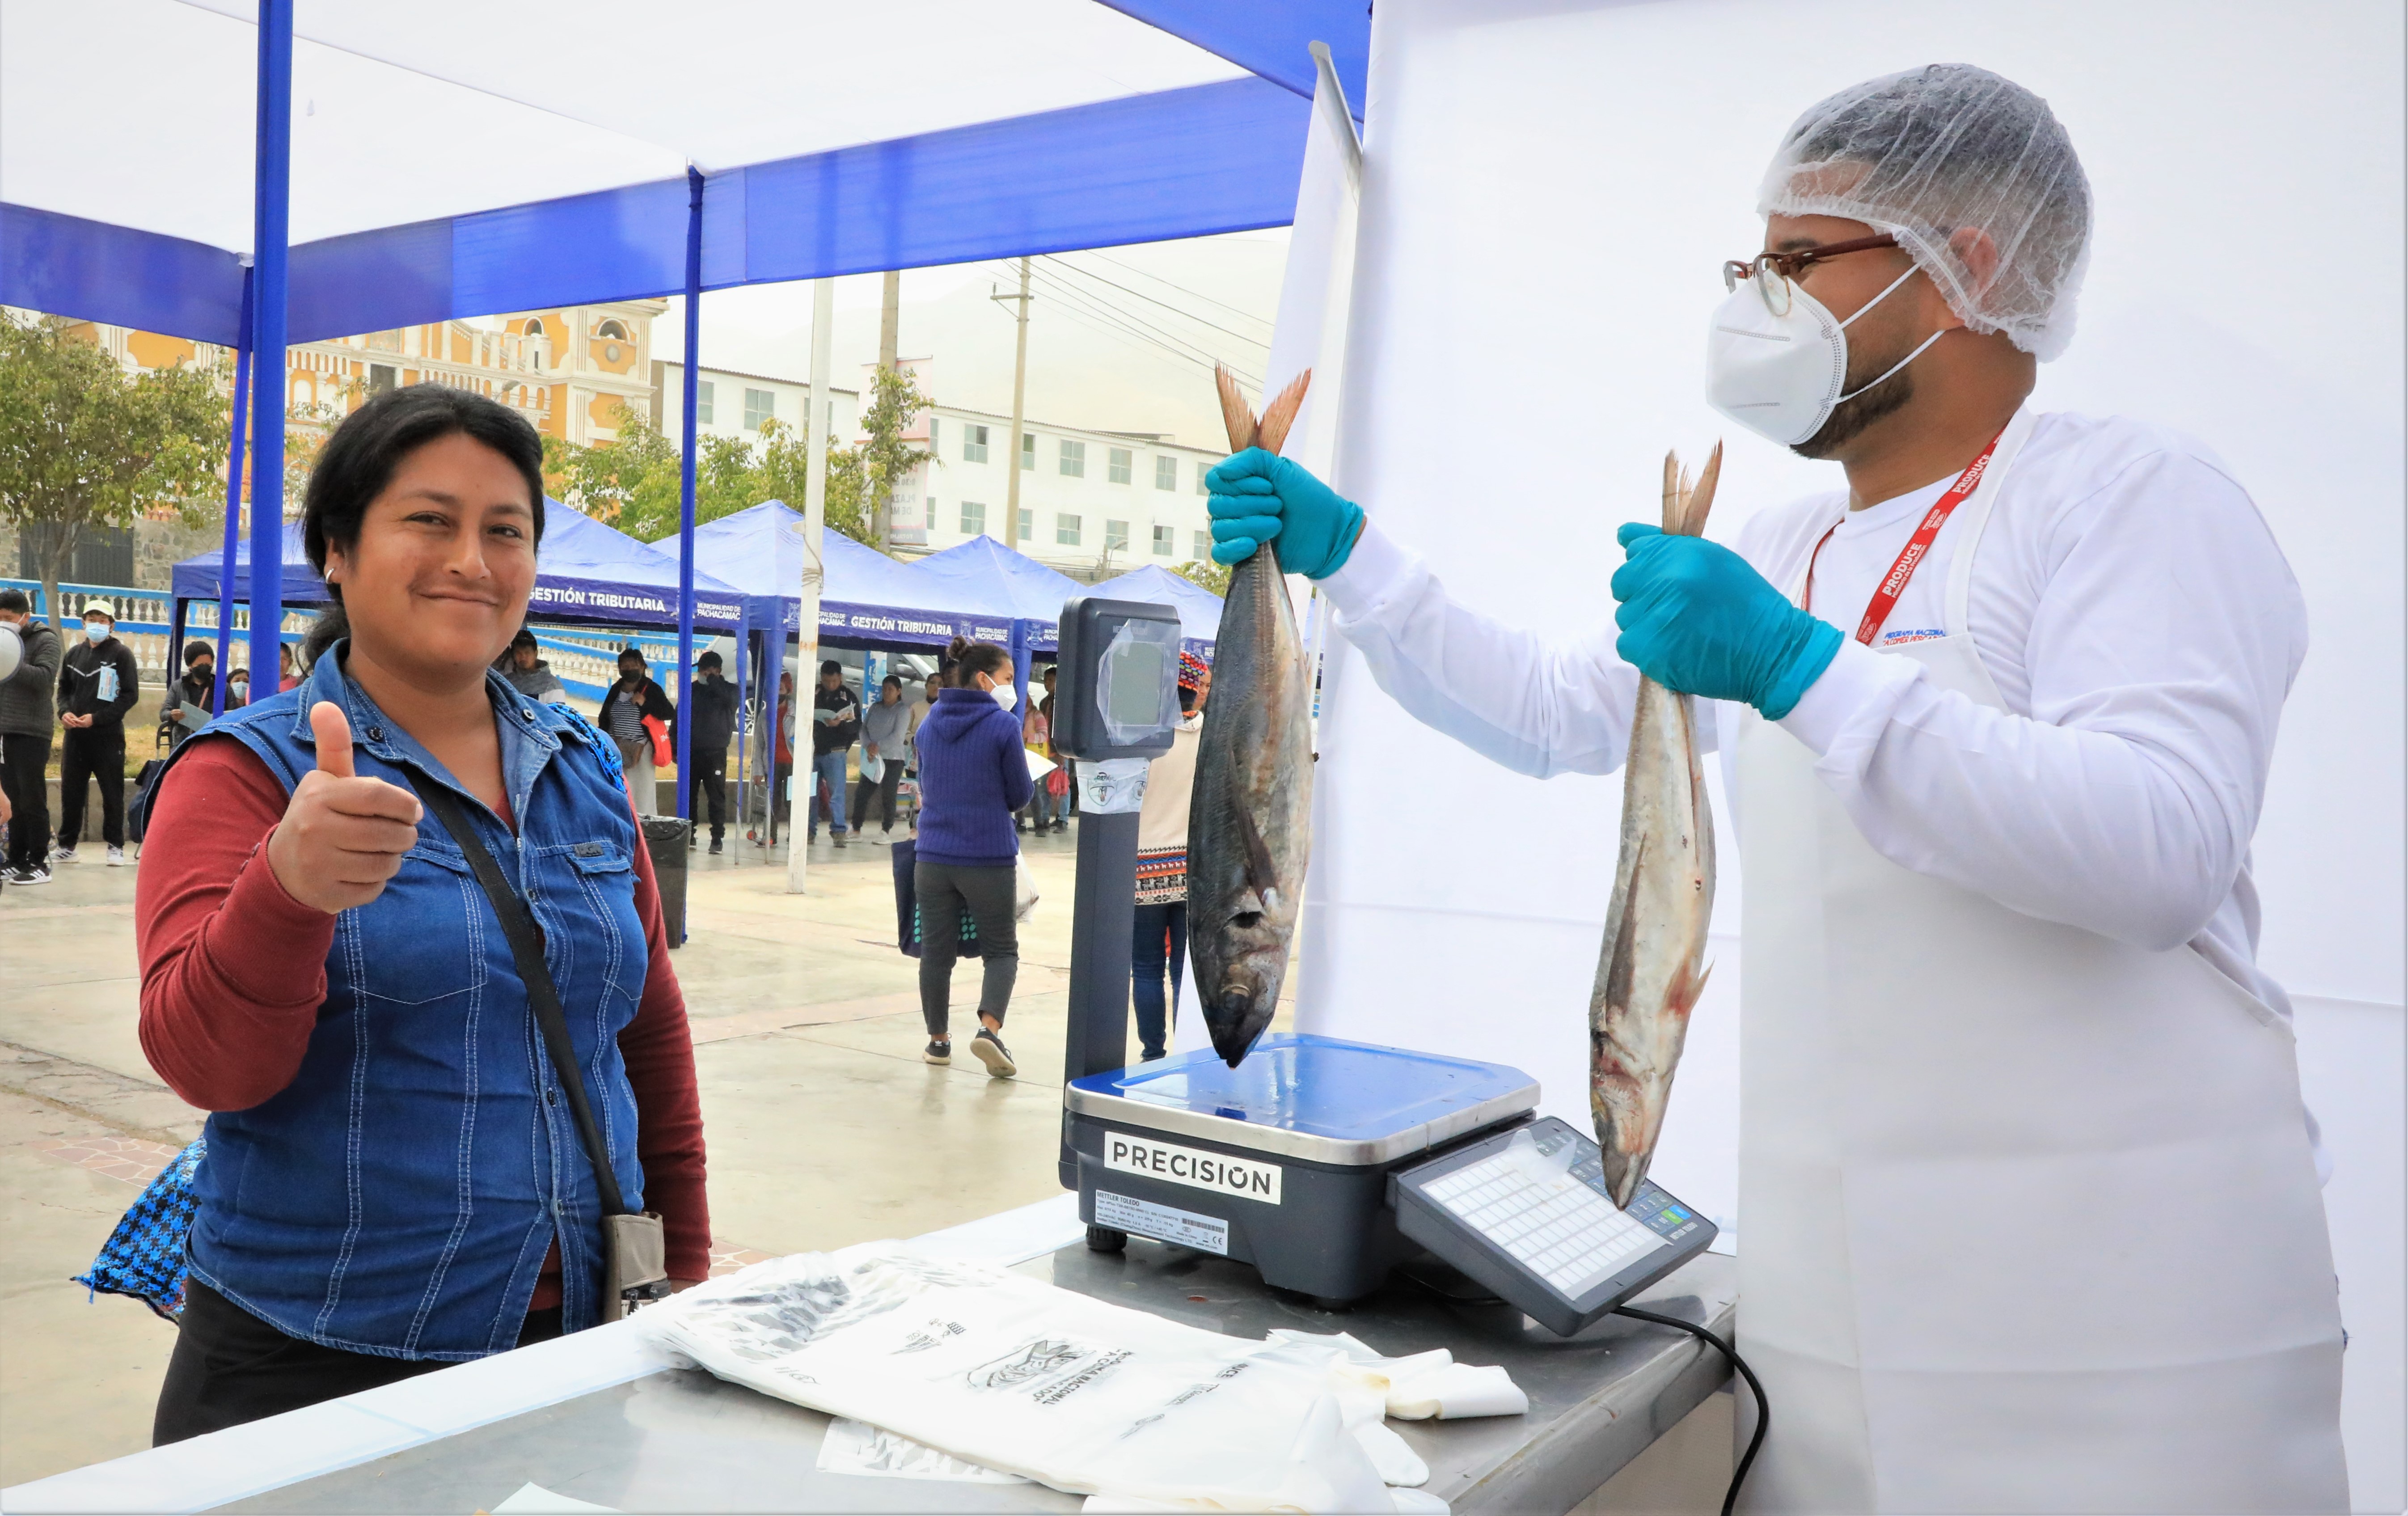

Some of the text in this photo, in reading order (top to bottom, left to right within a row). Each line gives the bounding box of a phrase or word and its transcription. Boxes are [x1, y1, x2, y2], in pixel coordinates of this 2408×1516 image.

[1952, 454, 1990, 493] PRODUCE
[1882, 543, 1923, 596] PRODUCE
[1891, 576, 1907, 598] Ministerio
[589, 593, 666, 612] TRIBUTARIA
[697, 602, 734, 611] MUNICIPALIDAD
[851, 616, 952, 635] GESTIÓN TRIBUTARIA
[1884, 630, 1913, 639] PROGRAMA
[1890, 636, 1909, 645] COMER
[1113, 1141, 1271, 1195] PRECISION
[1097, 1192, 1140, 1206] METTLER TOLEDO
[1682, 1222, 1698, 1232] TOLEDO
[1042, 1375, 1092, 1405] NACIONAL
